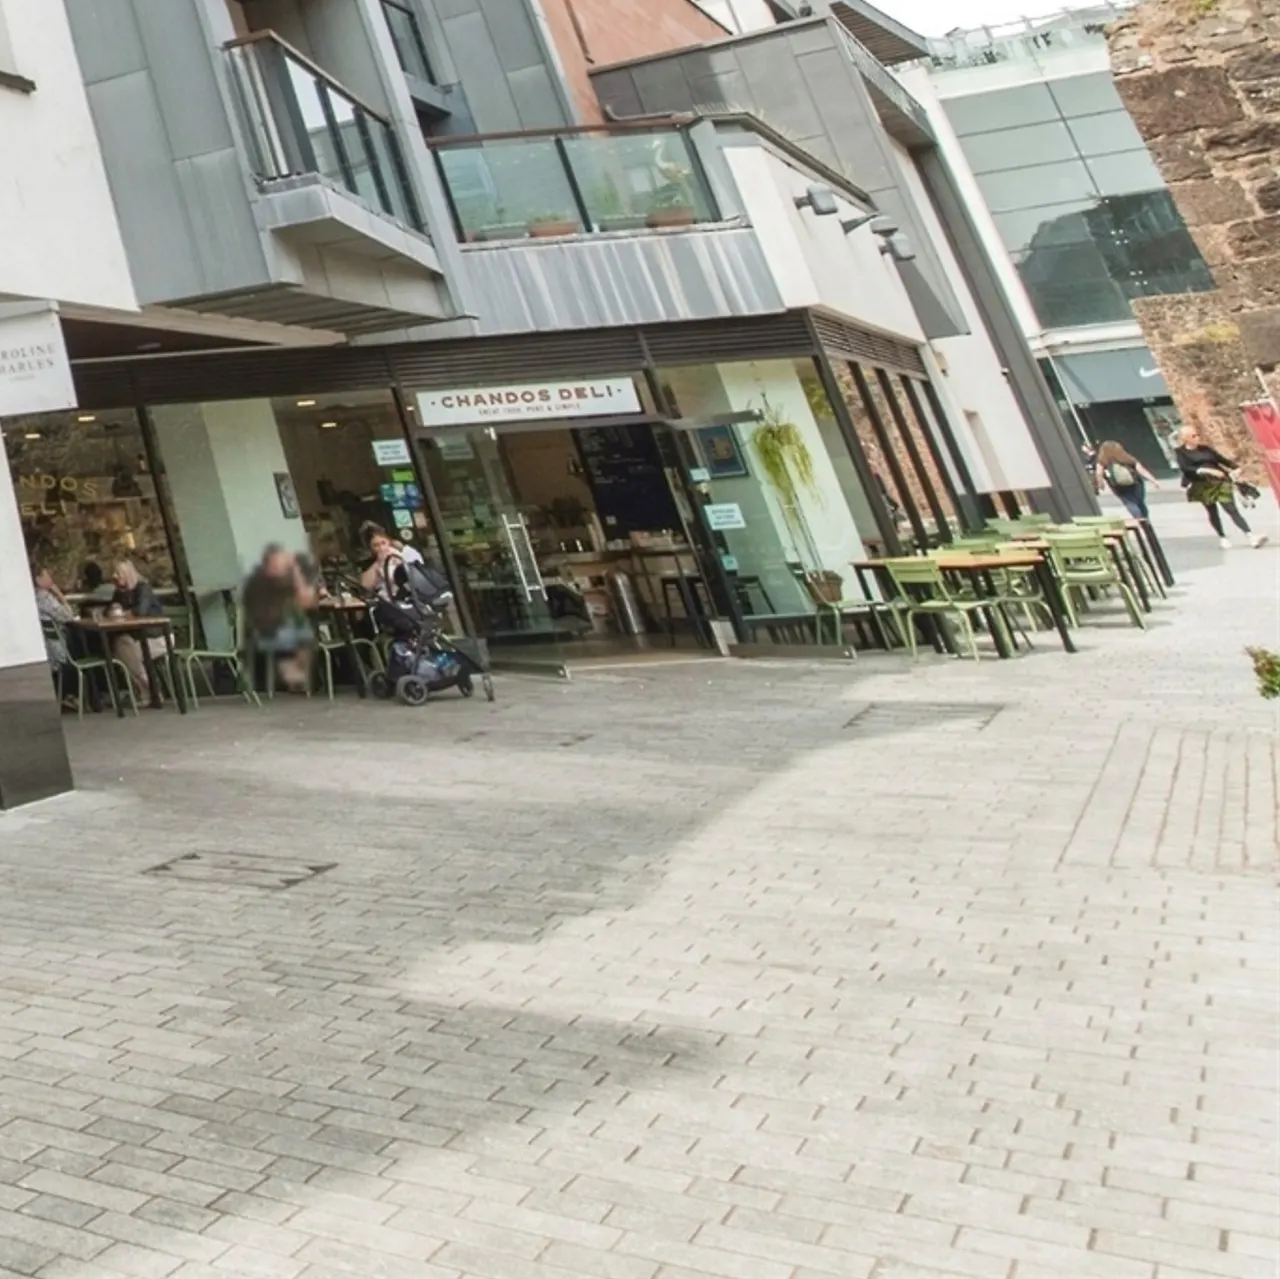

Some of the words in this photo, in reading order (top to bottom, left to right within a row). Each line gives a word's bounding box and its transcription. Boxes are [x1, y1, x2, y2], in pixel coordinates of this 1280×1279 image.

[441, 388, 552, 409] CHANDOS
[558, 384, 613, 401] DELI
[19, 474, 98, 499] NDOS
[20, 499, 68, 517] ELI
